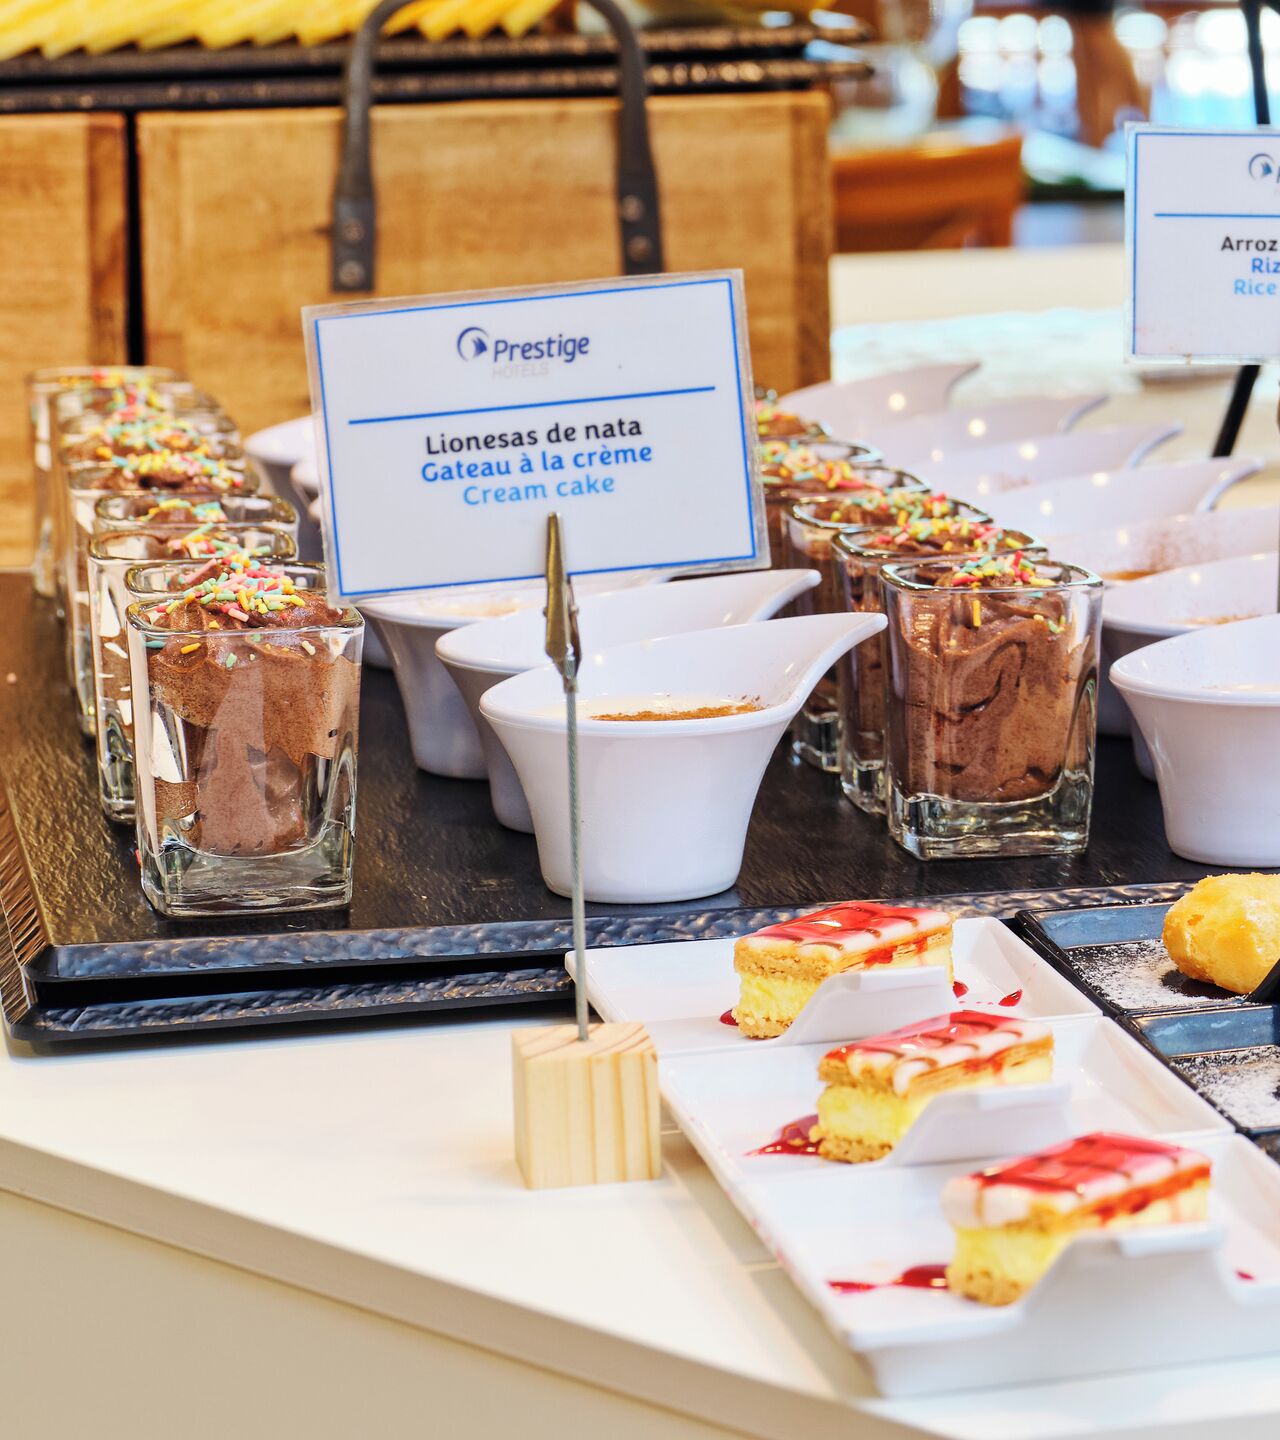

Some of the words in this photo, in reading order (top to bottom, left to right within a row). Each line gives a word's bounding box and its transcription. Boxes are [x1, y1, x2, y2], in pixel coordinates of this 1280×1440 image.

[1220, 235, 1279, 252] Arroz
[1233, 278, 1277, 295] Rice
[493, 333, 590, 364] Prestige
[492, 362, 550, 379] HOTELS
[426, 429, 539, 456] Lionesas
[546, 422, 577, 444] de
[585, 418, 643, 440] nata
[421, 459, 512, 482] Gateau
[520, 452, 534, 474] à
[541, 450, 565, 471] la
[573, 444, 653, 468] crème
[463, 482, 548, 506] Cream
[556, 474, 615, 497] cake
